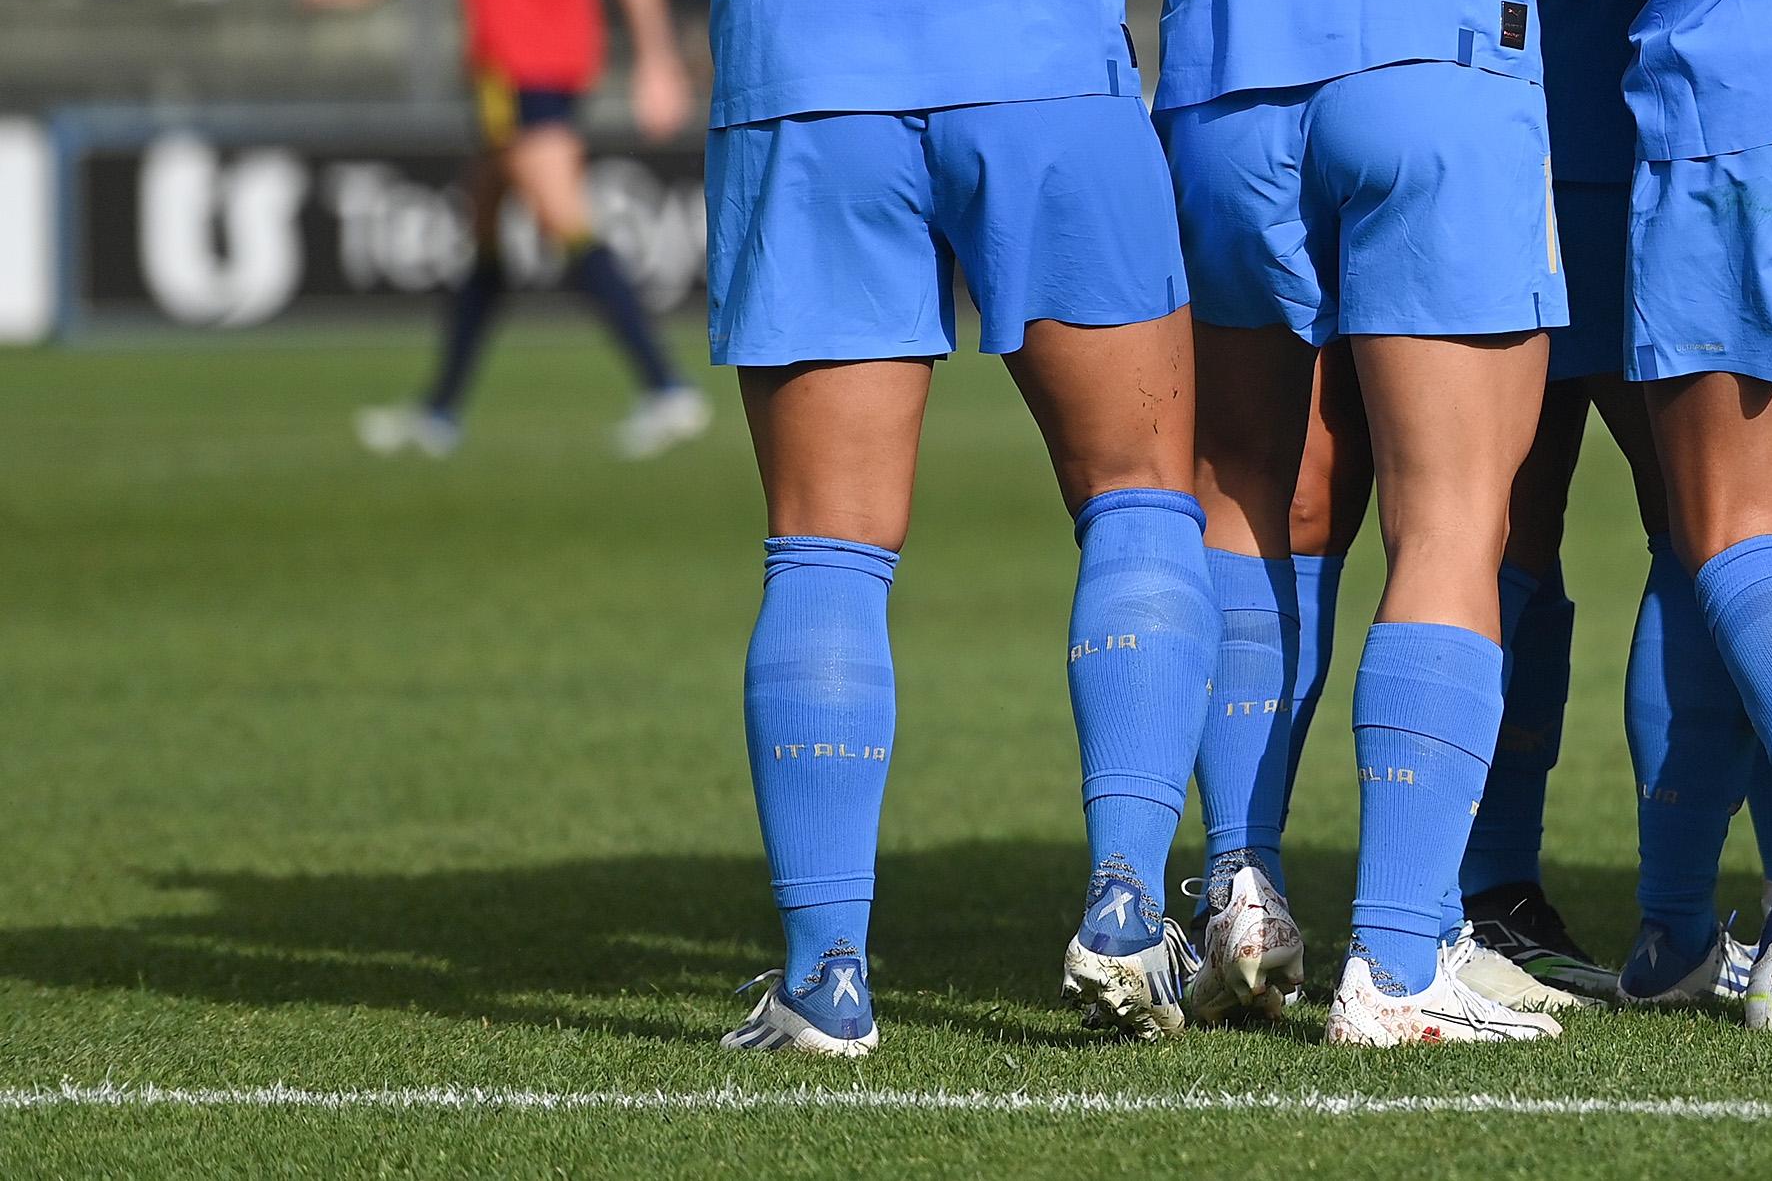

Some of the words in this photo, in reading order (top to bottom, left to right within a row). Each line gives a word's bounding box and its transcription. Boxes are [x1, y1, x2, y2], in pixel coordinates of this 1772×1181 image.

[1070, 633, 1137, 663] ALIA
[1226, 698, 1290, 717] ITAL
[774, 742, 886, 762] ITALIA
[1359, 766, 1415, 786] ALIA
